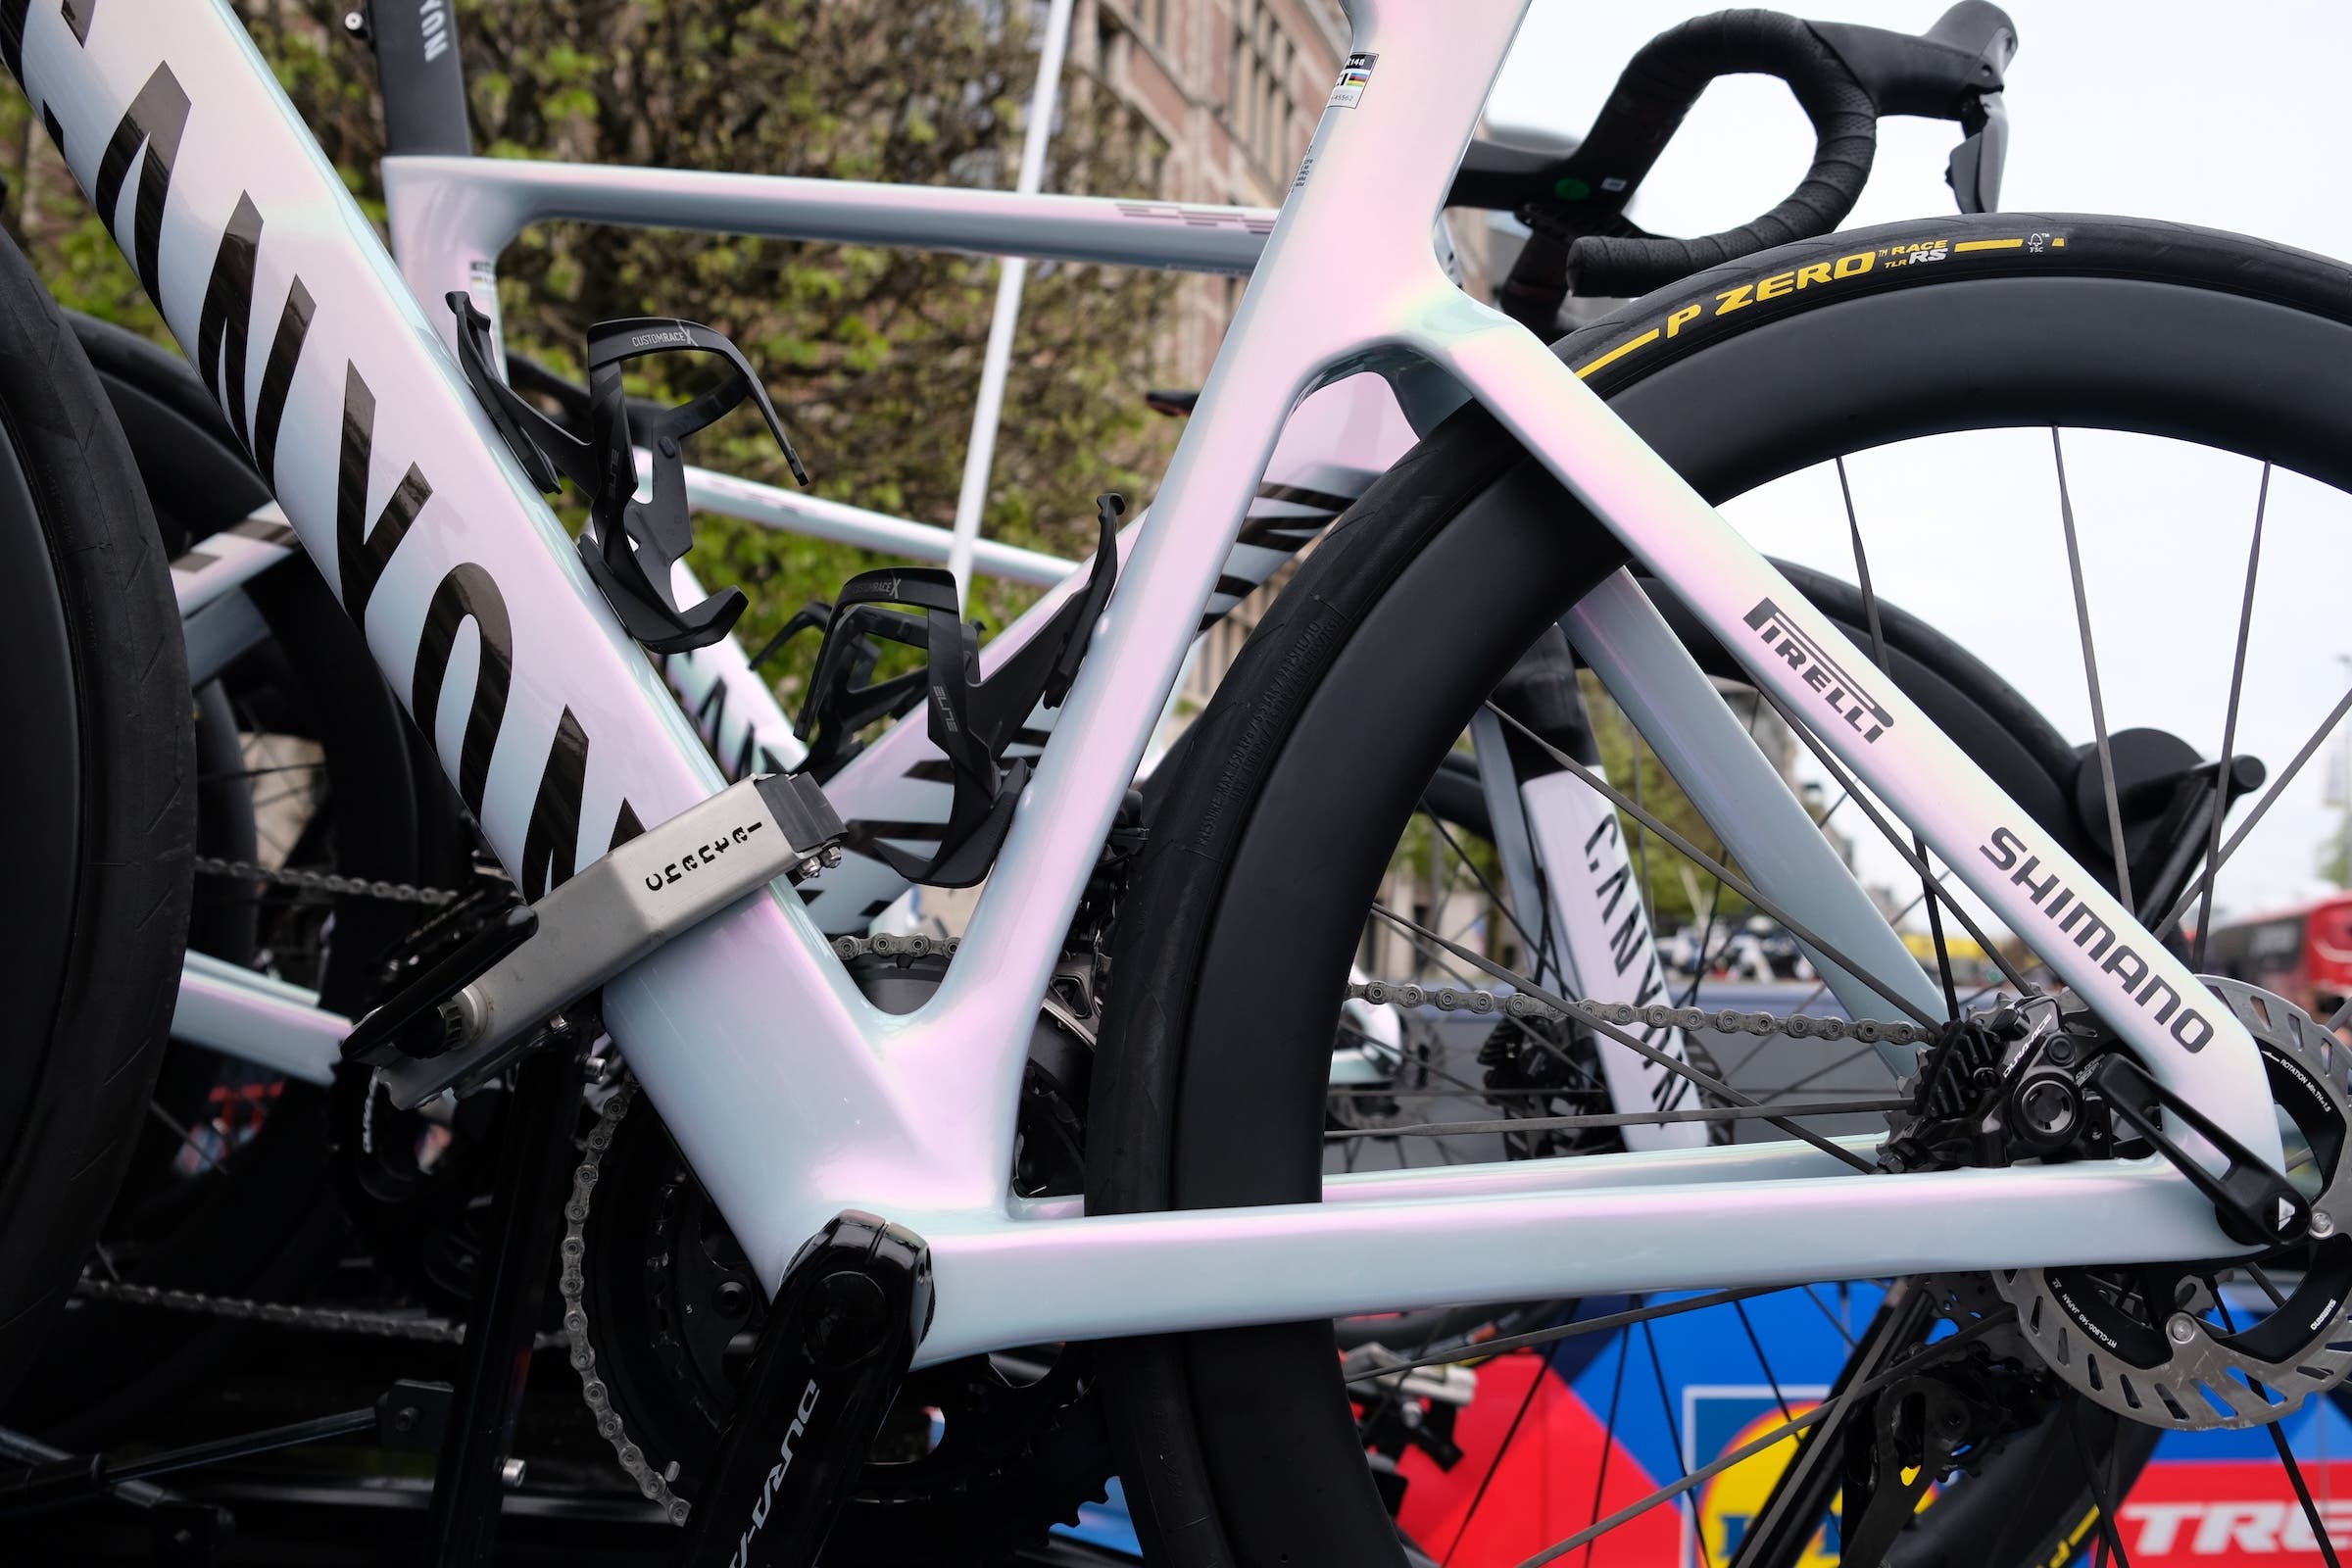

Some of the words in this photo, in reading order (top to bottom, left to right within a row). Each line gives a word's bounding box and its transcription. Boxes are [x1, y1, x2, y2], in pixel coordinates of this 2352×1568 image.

[1884, 259, 1907, 270] TLR
[1908, 248, 1948, 266] RS
[1891, 239, 1948, 255] RACE
[1666, 305, 1702, 339] P
[1714, 251, 1877, 317] ZERO
[1742, 596, 1894, 744] PIRELLI
[933, 685, 958, 733] ELITE
[645, 821, 762, 891] Chantal
[1979, 826, 2215, 1054] SHIMANO
[2002, 1012, 2053, 1079] DURA-ACE
[2279, 1058, 2308, 1085] ROTATION
[2061, 1293, 2081, 1317] JAPAN
[2310, 1298, 2337, 1331] SHIMANO
[2121, 1499, 2352, 1557] TRE
